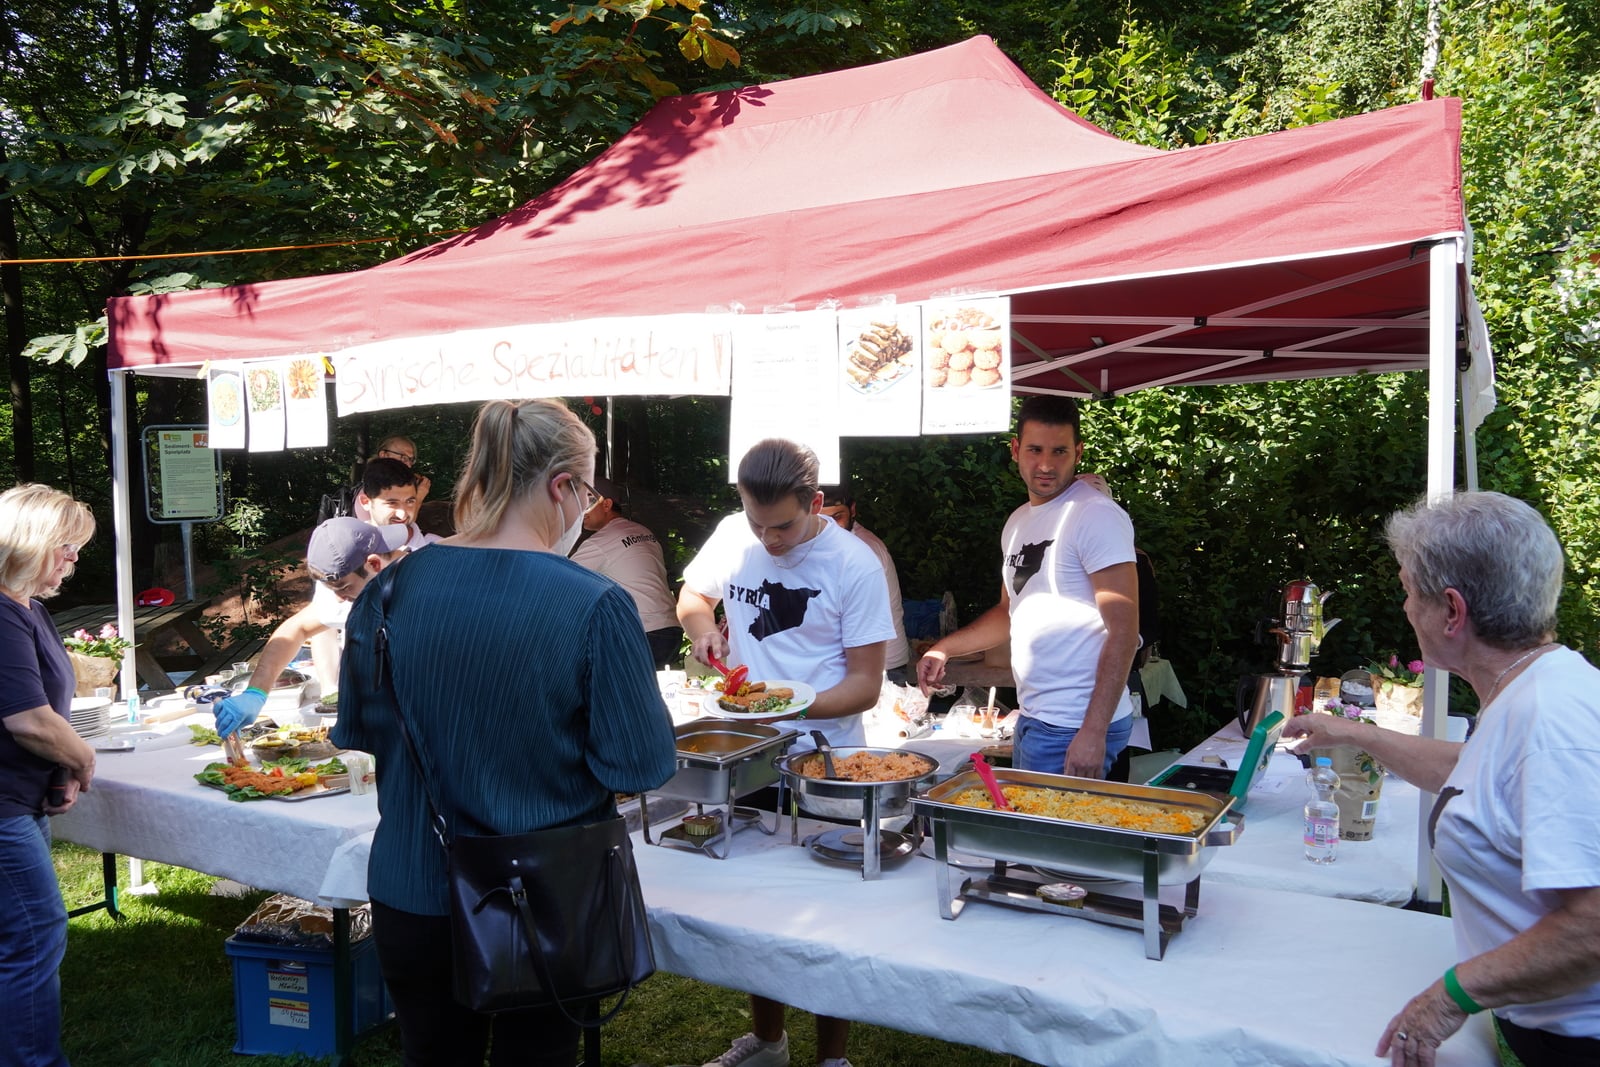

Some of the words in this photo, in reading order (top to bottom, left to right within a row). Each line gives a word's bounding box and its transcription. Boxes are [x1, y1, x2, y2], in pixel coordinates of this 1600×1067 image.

[341, 347, 480, 406] Syrische
[493, 331, 699, 391] Spezialitäten
[729, 584, 770, 610] SYRIA
